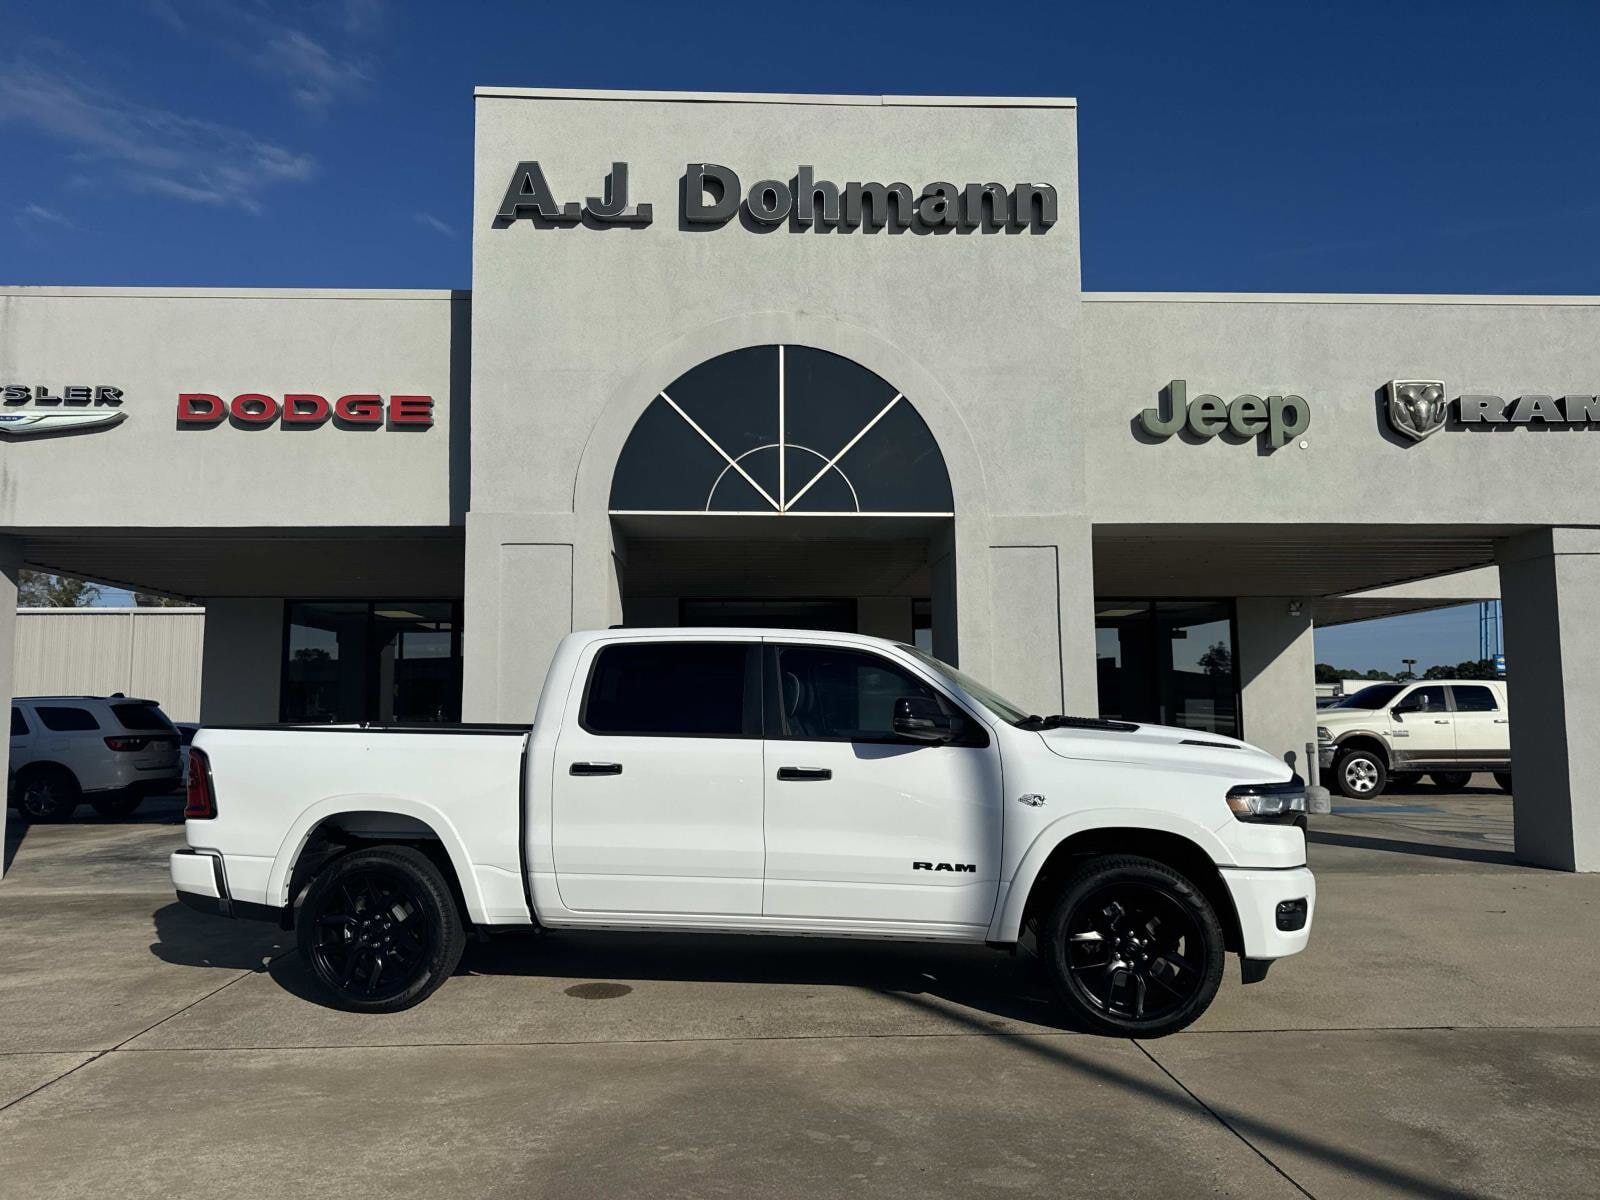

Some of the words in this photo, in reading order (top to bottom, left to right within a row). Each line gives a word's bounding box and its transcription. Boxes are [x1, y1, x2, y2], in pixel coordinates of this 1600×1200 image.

[495, 160, 653, 224] A.J.
[683, 162, 1058, 225] Dohmann
[0, 385, 122, 403] SLER
[177, 393, 434, 428] DODGE
[1140, 379, 1311, 450] Jeep
[912, 861, 977, 873] RAM
